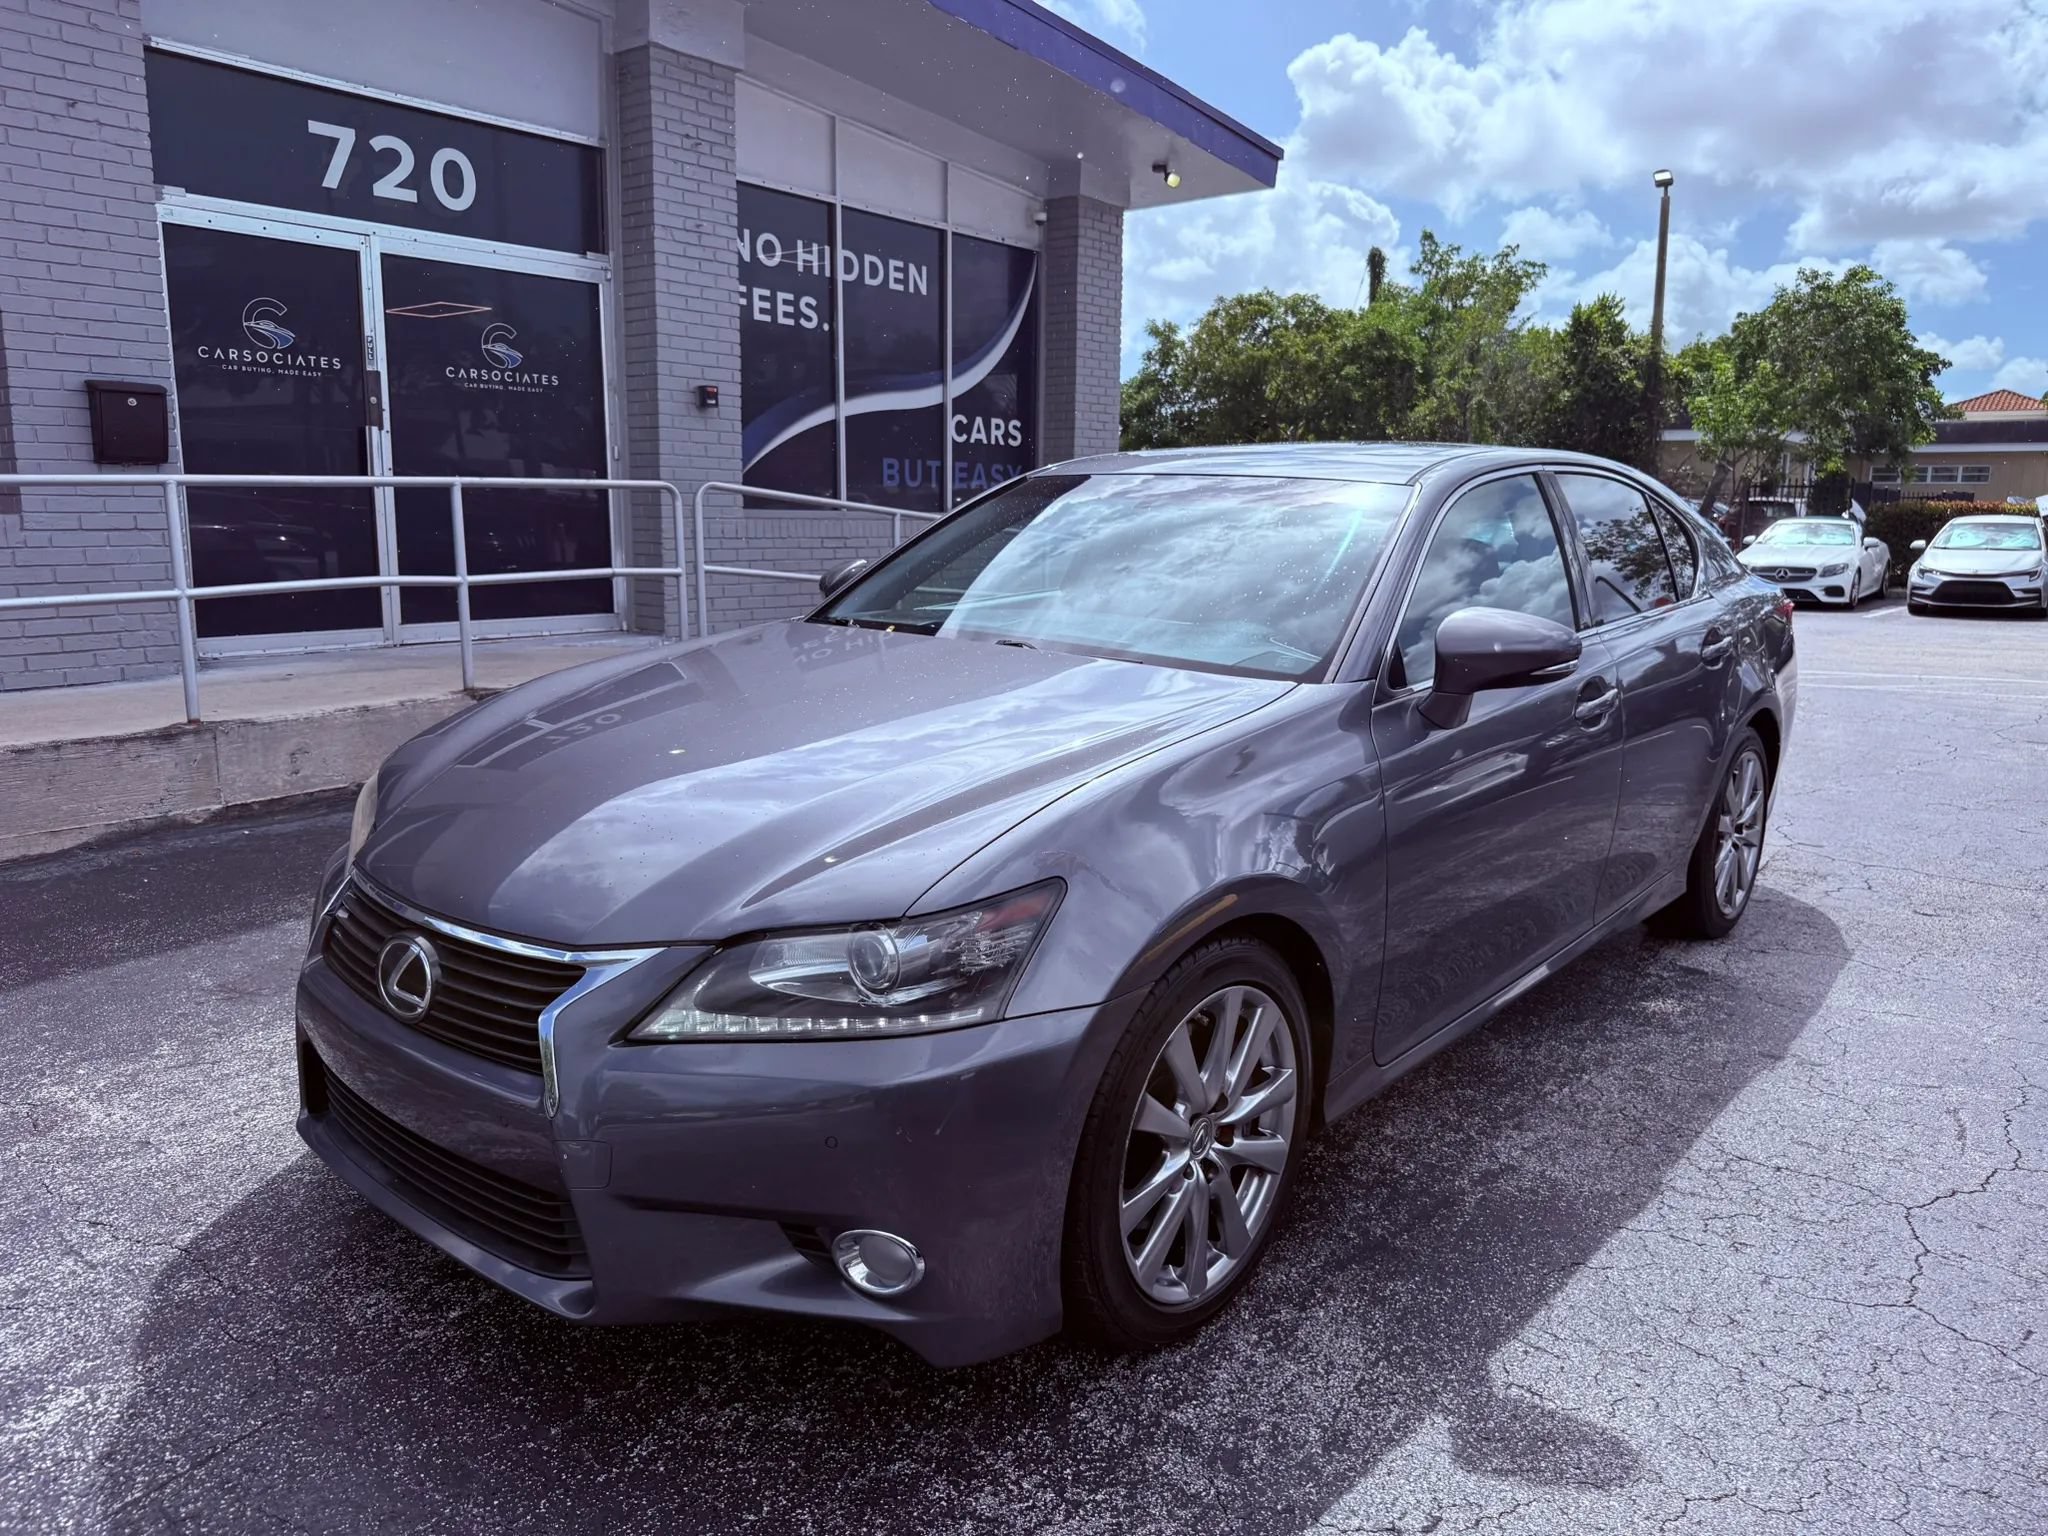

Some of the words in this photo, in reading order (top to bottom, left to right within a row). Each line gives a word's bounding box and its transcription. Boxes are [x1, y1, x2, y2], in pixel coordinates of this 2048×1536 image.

[307, 119, 477, 212] 720
[796, 239, 927, 296] HIDDEN
[197, 345, 342, 370] CARSOCIATES
[445, 366, 559, 386] CARSOCIATES
[951, 413, 1023, 447] CARS
[882, 457, 942, 489] BUT
